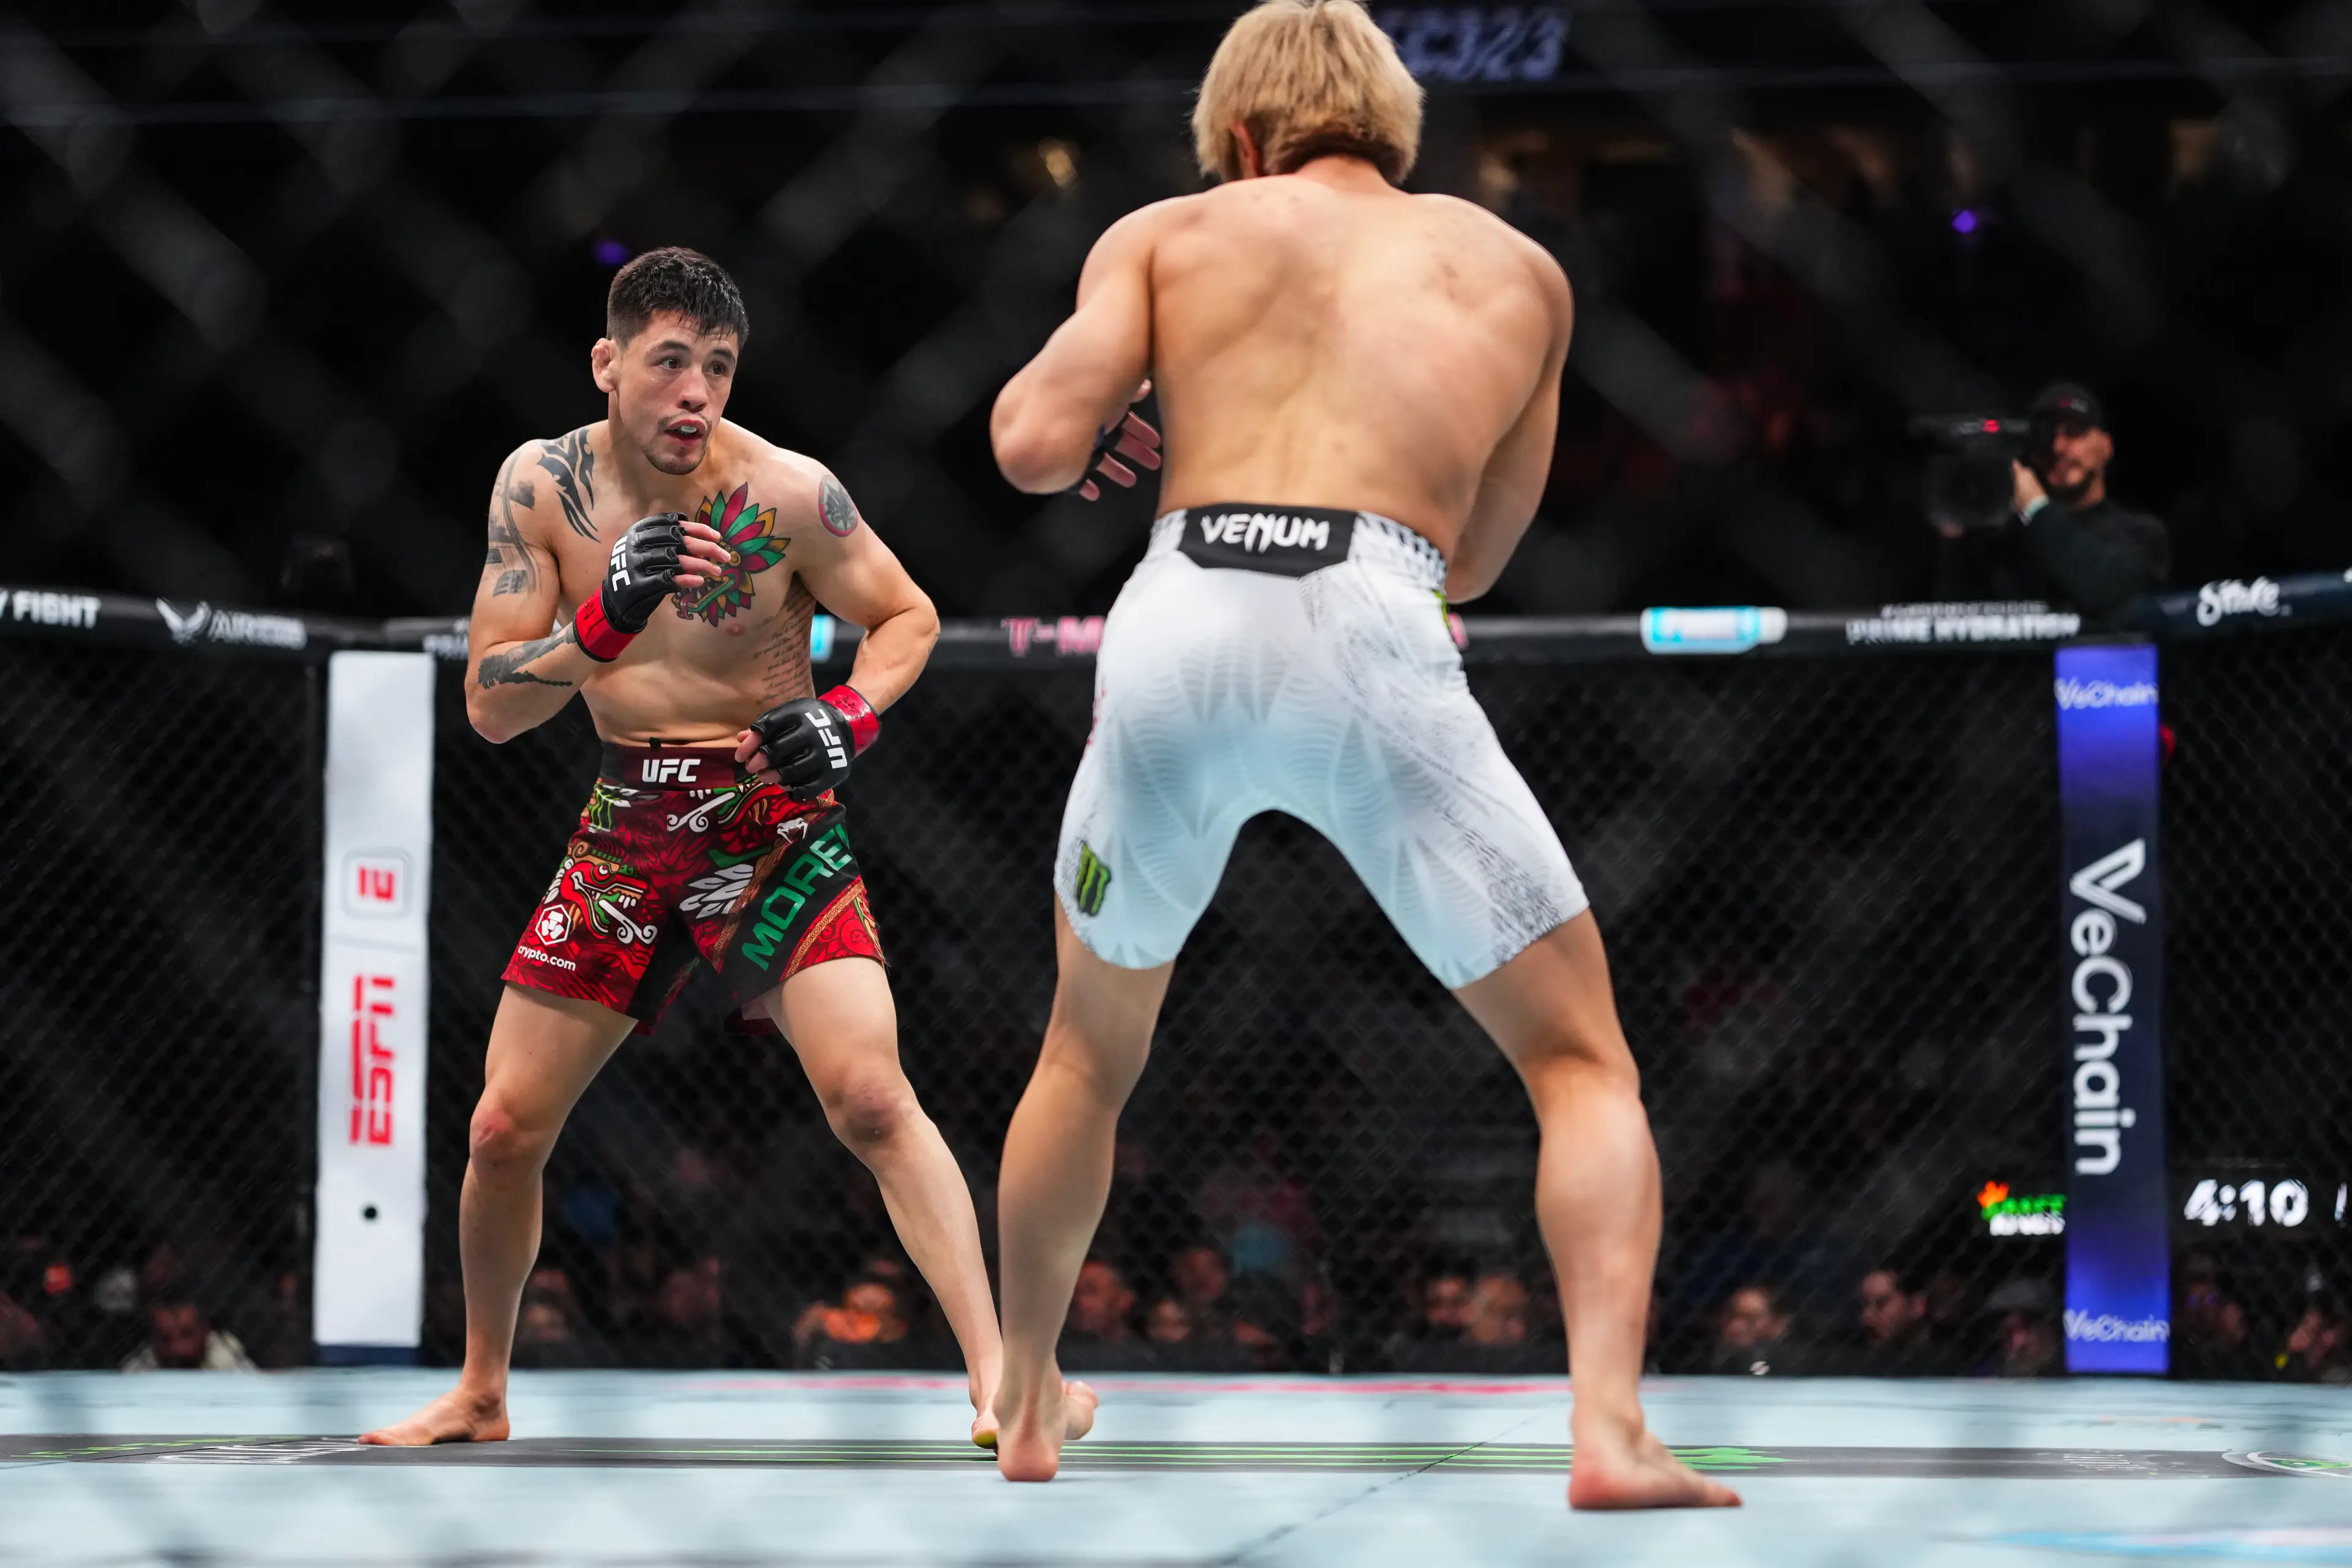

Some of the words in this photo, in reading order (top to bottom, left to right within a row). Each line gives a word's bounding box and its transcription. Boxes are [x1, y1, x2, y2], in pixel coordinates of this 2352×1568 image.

[1200, 513, 1330, 553] VENUM
[609, 535, 631, 592] UFC
[12, 590, 101, 629] FIGHT
[2054, 677, 2158, 709] VeChain
[805, 709, 848, 769] UFC
[642, 759, 701, 783] UFC
[742, 823, 854, 971] MORE
[516, 944, 577, 972] crypto.com
[2070, 838, 2147, 1176] VeChain
[350, 975, 394, 1145] ESPN
[2185, 1178, 2309, 1227] 4:10
[2062, 1310, 2171, 1343] VeChain
